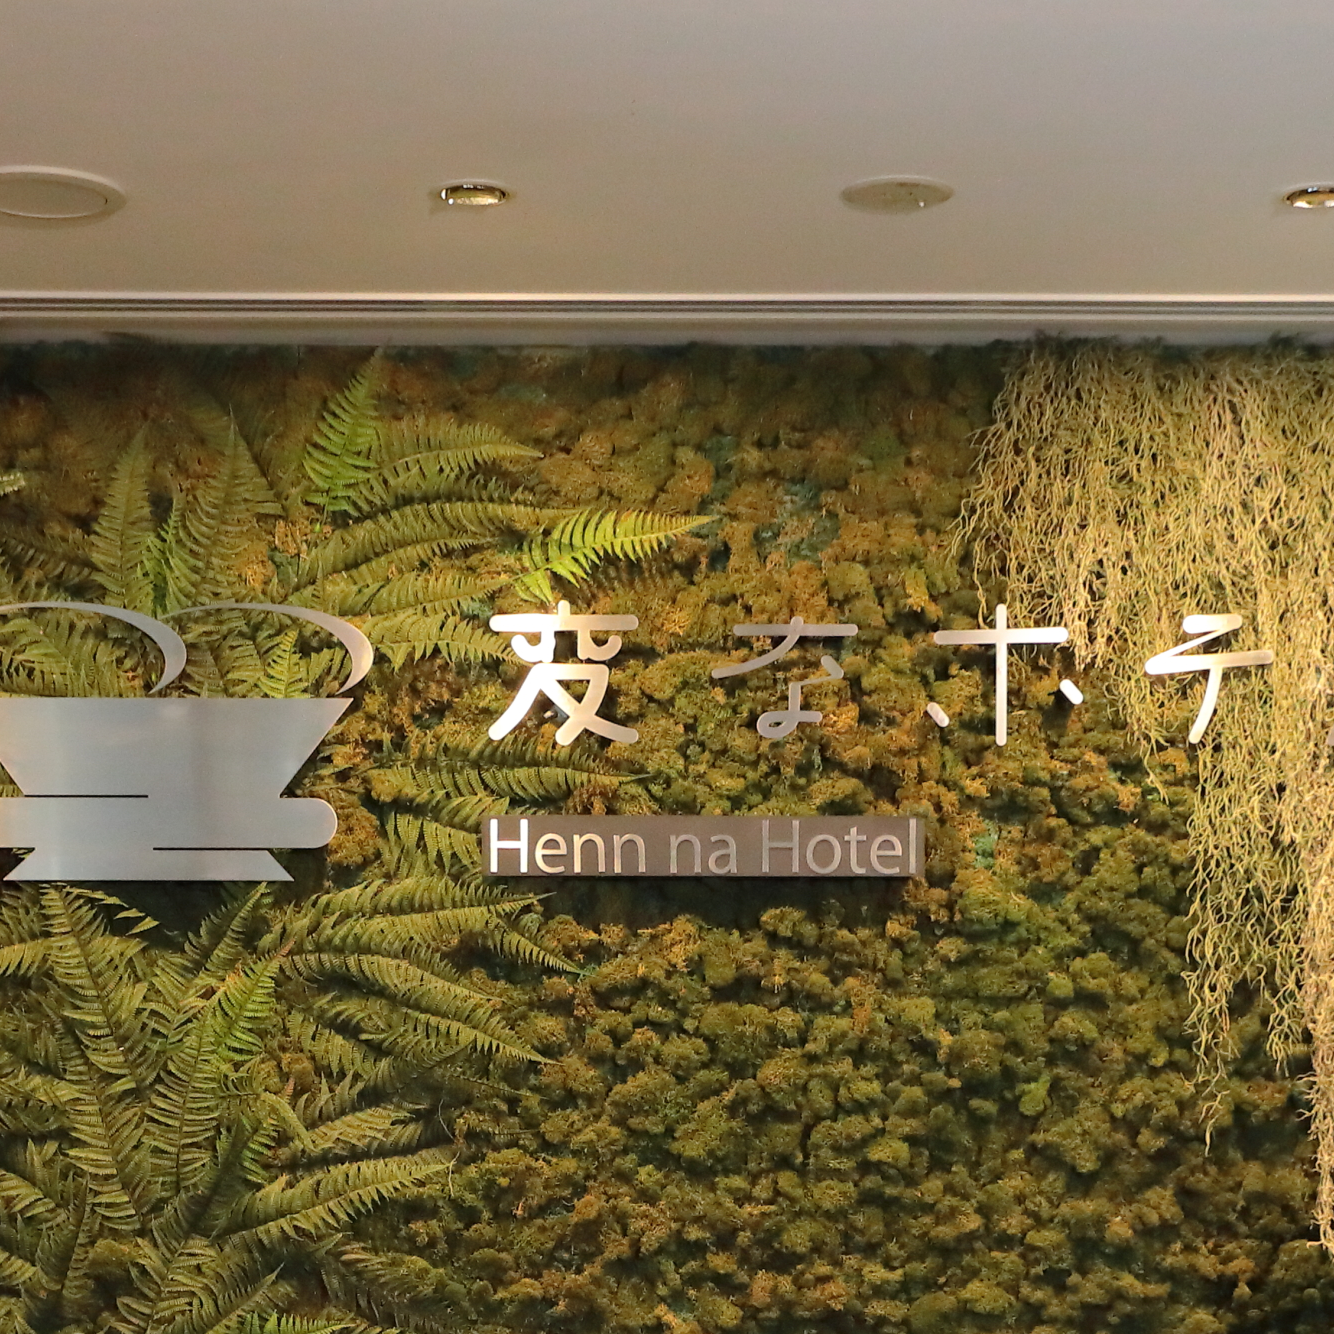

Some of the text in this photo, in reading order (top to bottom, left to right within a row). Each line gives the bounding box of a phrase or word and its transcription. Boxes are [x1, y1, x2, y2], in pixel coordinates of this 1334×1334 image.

[489, 818, 917, 874] Henn na Hotel
